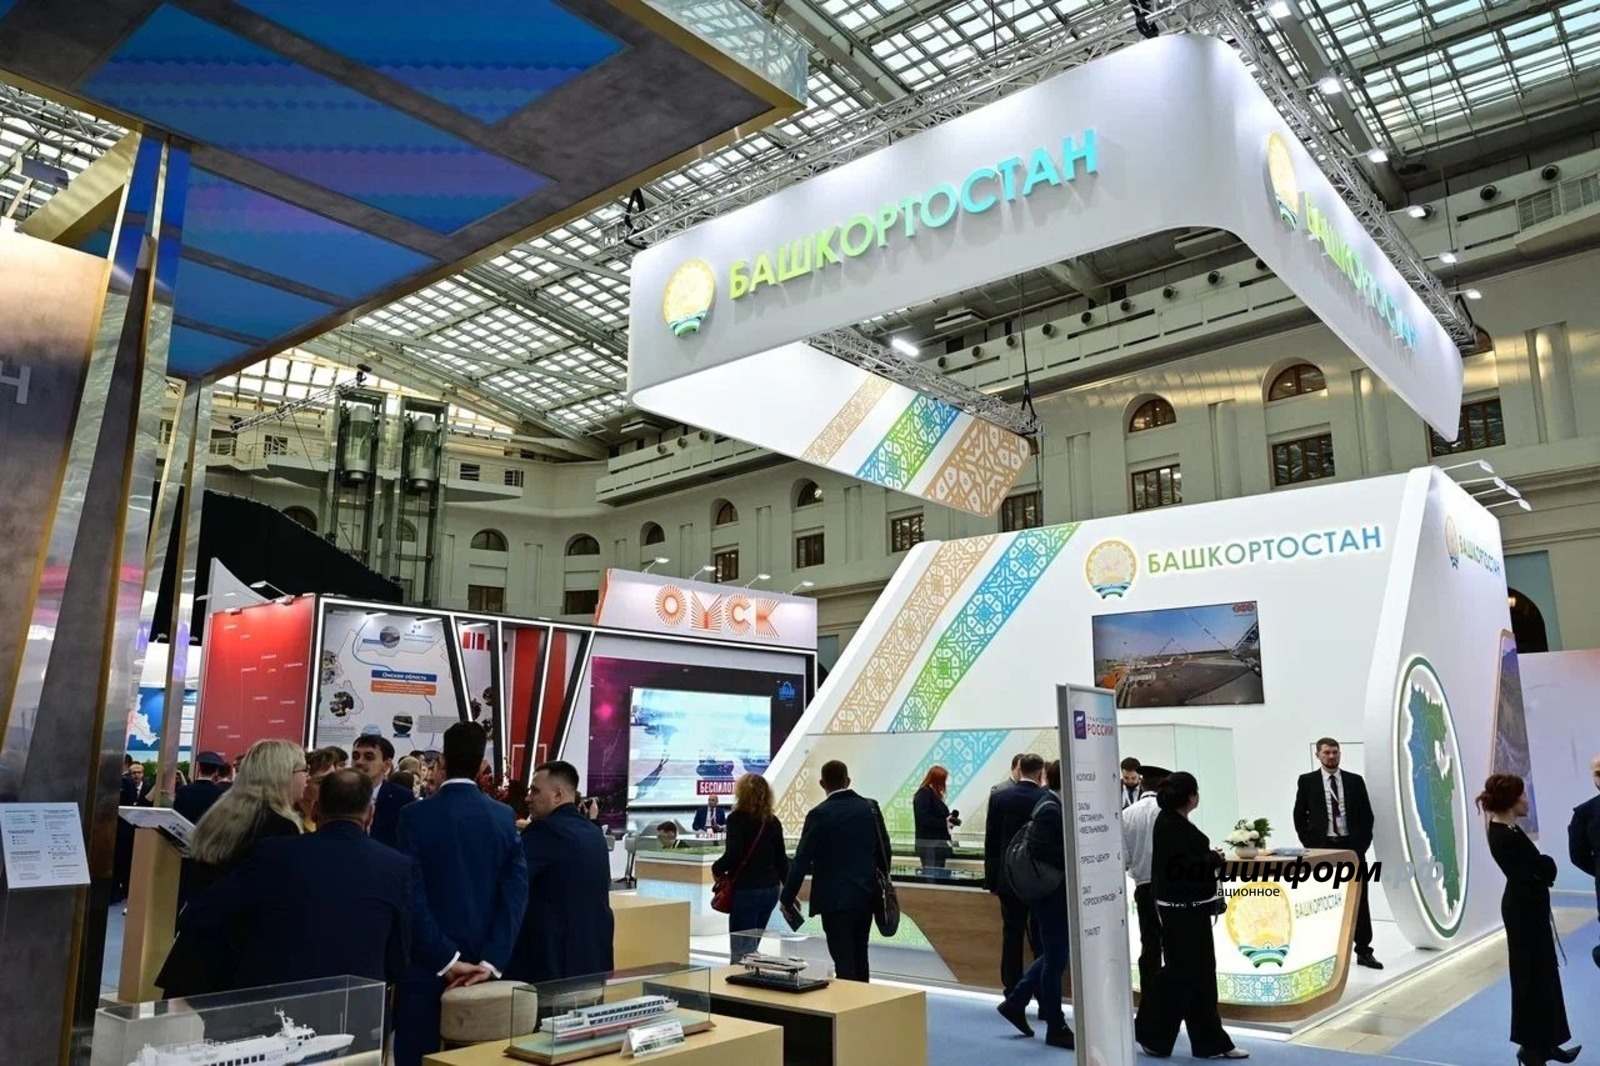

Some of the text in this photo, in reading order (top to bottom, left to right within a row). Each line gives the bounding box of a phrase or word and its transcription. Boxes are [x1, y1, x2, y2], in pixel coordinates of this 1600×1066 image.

[728, 128, 1098, 300] БАШКОРТОСТАН
[1304, 191, 1417, 350] БАШКОРТОСТАН
[1147, 525, 1382, 574] БАШКОРТОСТАН
[1459, 534, 1501, 577] БАШКОРТОСТАН
[655, 584, 780, 638] ОМСК
[1087, 724, 1114, 735] РОССИИ
[1295, 893, 1342, 919] БАШКОРТОСТАН
